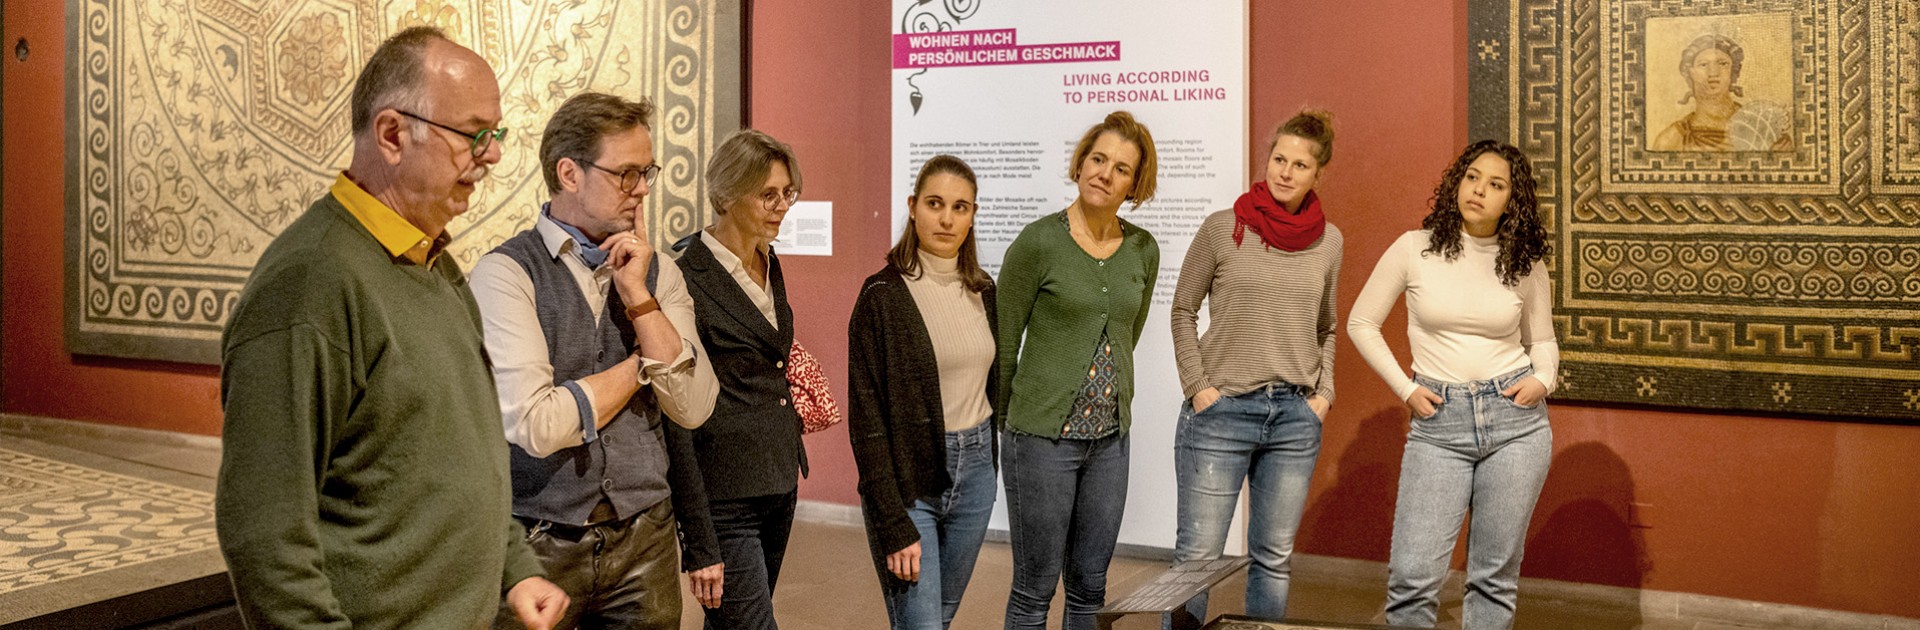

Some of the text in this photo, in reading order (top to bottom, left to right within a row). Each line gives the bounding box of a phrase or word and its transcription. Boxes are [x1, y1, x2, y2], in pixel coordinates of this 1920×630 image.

[908, 32, 1012, 48] WOHNEN NACH
[908, 44, 1116, 66] PERSÖNLICHEM GESCHMACK
[1064, 70, 1210, 86] LIVING ACCORDING
[1064, 88, 1226, 104] TO PERSONAL LIKING
